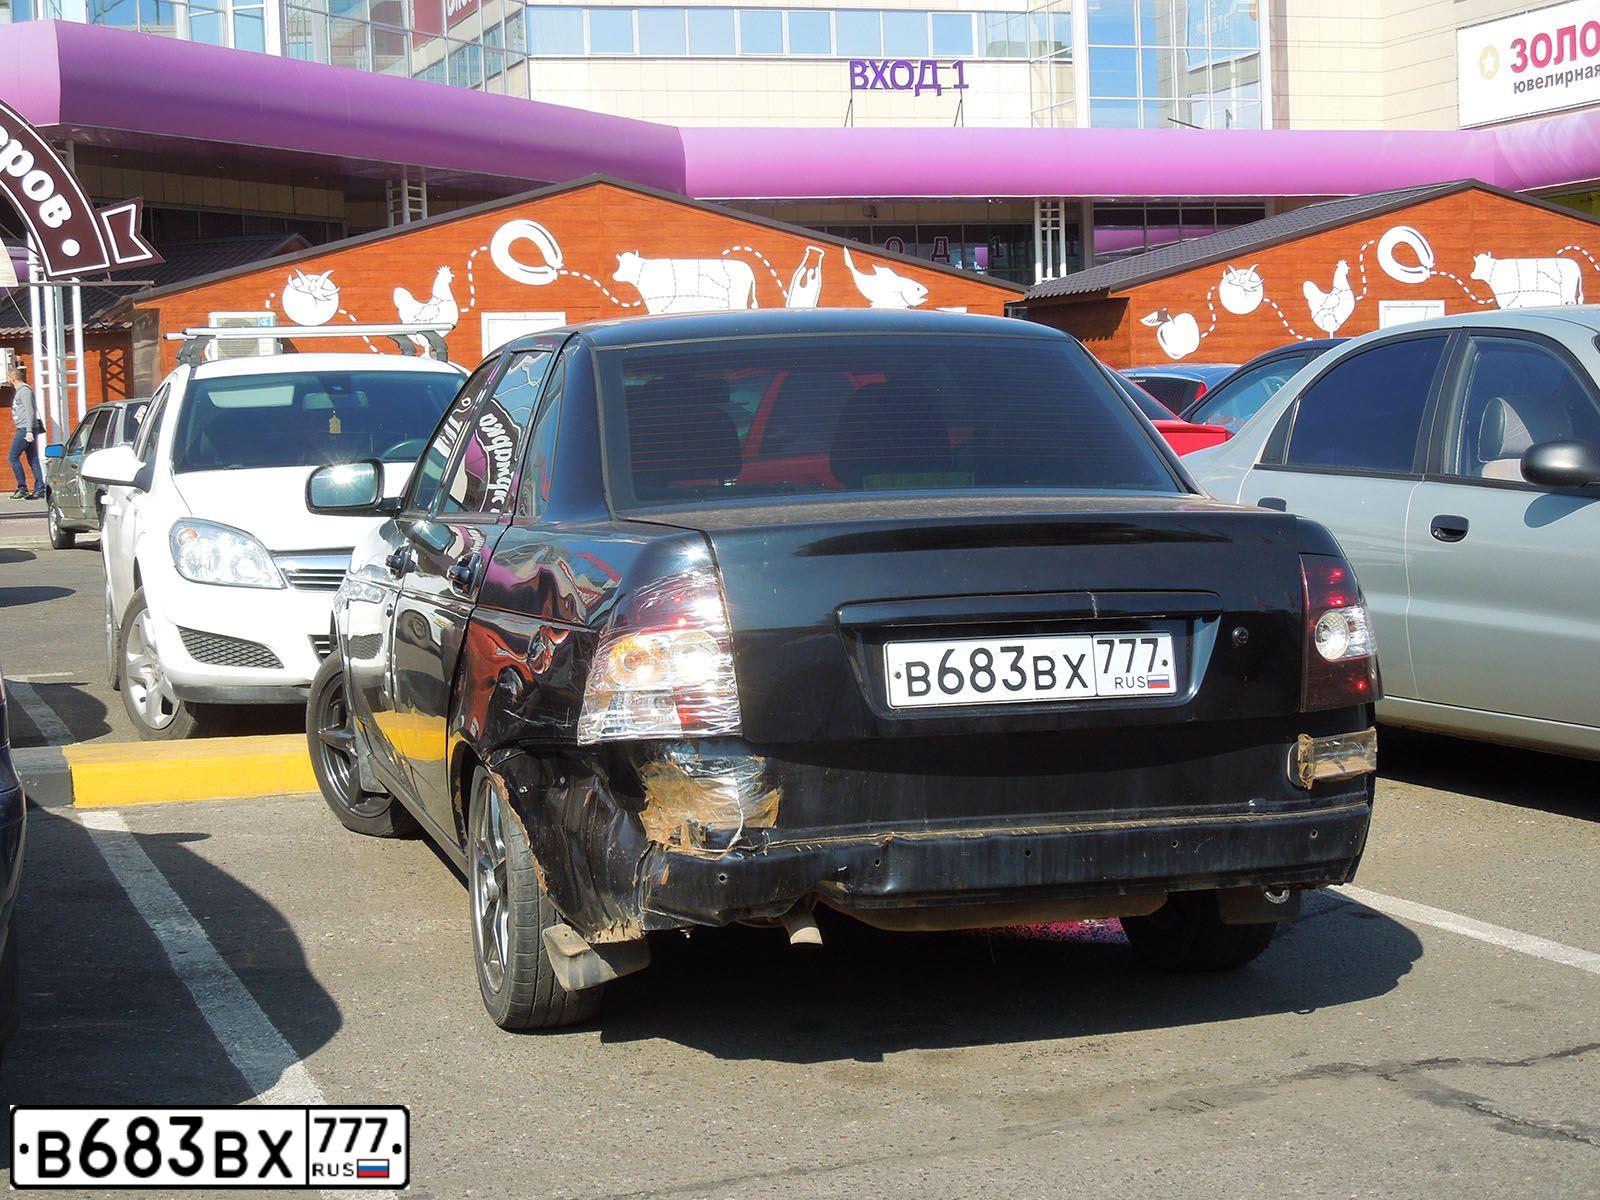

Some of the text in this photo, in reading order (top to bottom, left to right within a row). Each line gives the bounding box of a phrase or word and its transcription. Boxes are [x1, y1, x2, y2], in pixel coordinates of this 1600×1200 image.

[1510, 20, 1600, 73] ЗОЛО
[850, 60, 969, 97] ВХОД 1
[1513, 63, 1600, 94] ювелирная
[905, 638, 1159, 697] В683ВХ 777
[1113, 675, 1146, 690] RUS
